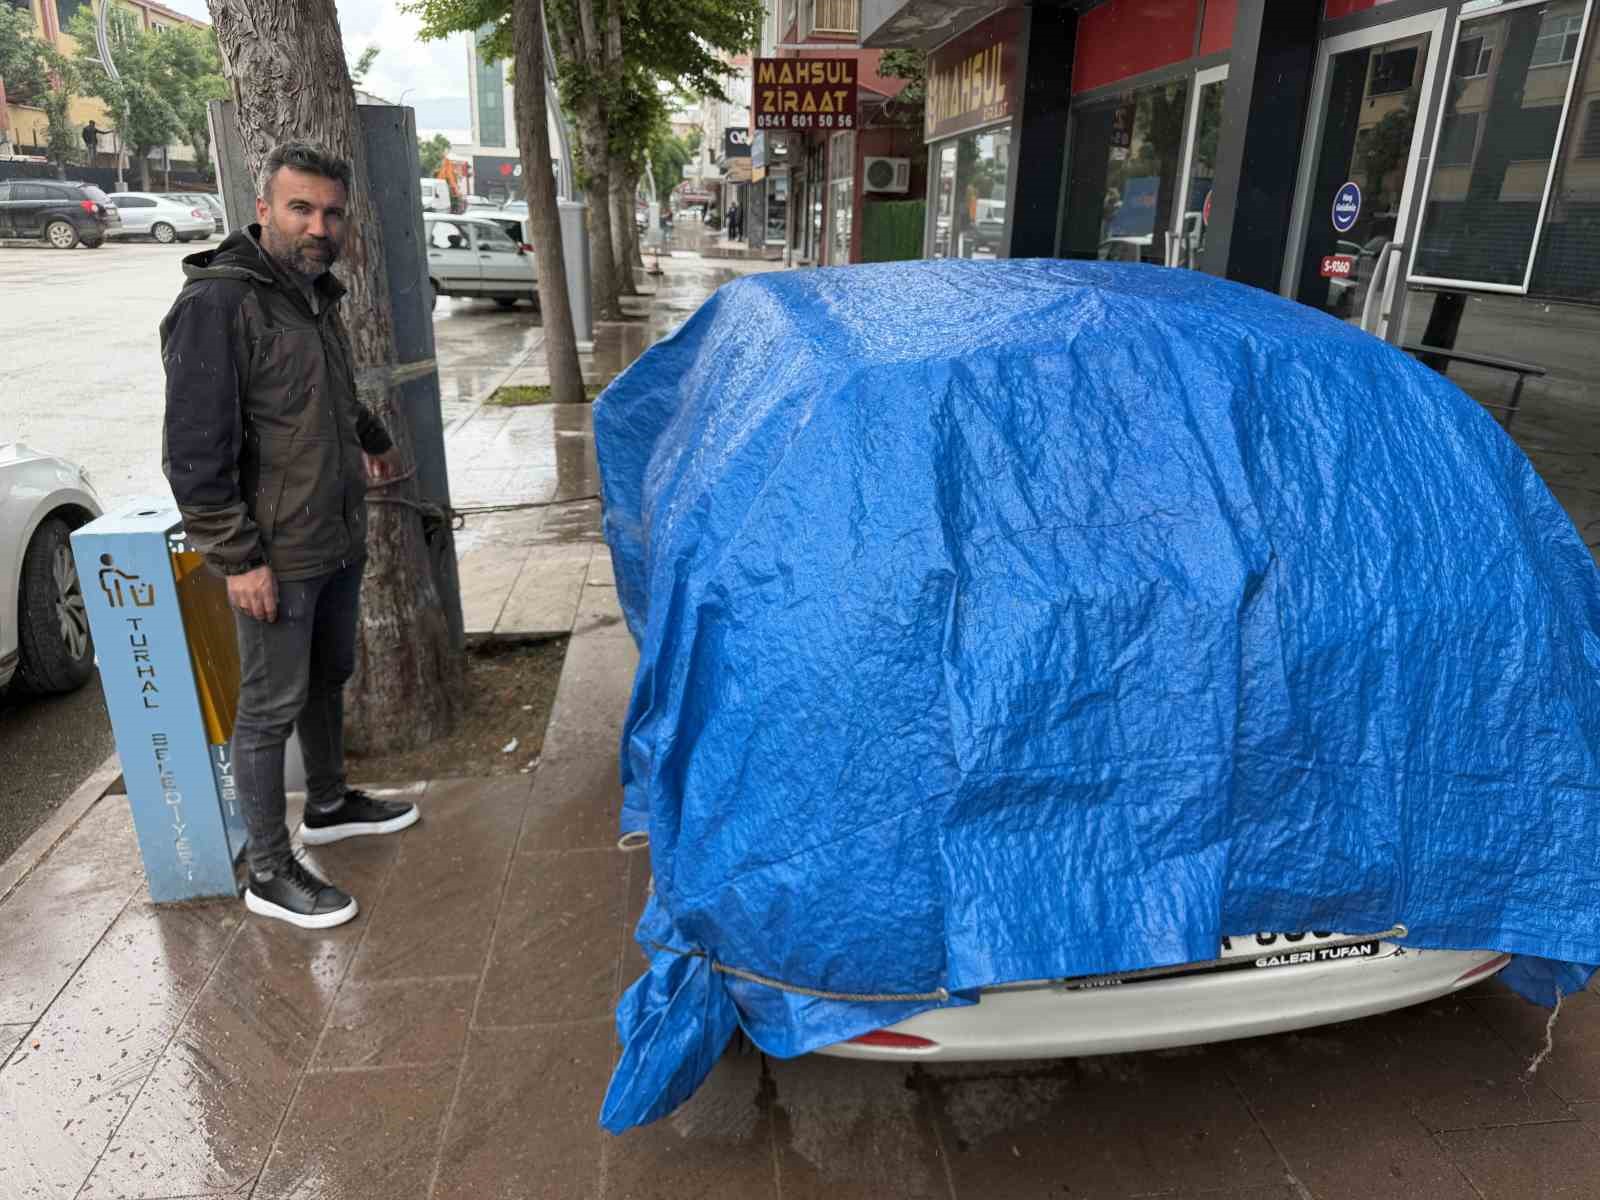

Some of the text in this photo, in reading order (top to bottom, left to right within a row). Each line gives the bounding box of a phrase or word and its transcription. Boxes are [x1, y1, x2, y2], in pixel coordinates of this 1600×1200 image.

[758, 62, 853, 84] MAHSUL
[938, 42, 1006, 121] MAHSUL
[762, 86, 849, 112] ZİRAAT
[758, 114, 852, 127] 0541 601 50 56
[126, 617, 160, 709] TURHAL
[1319, 943, 1372, 961] TUFAN
